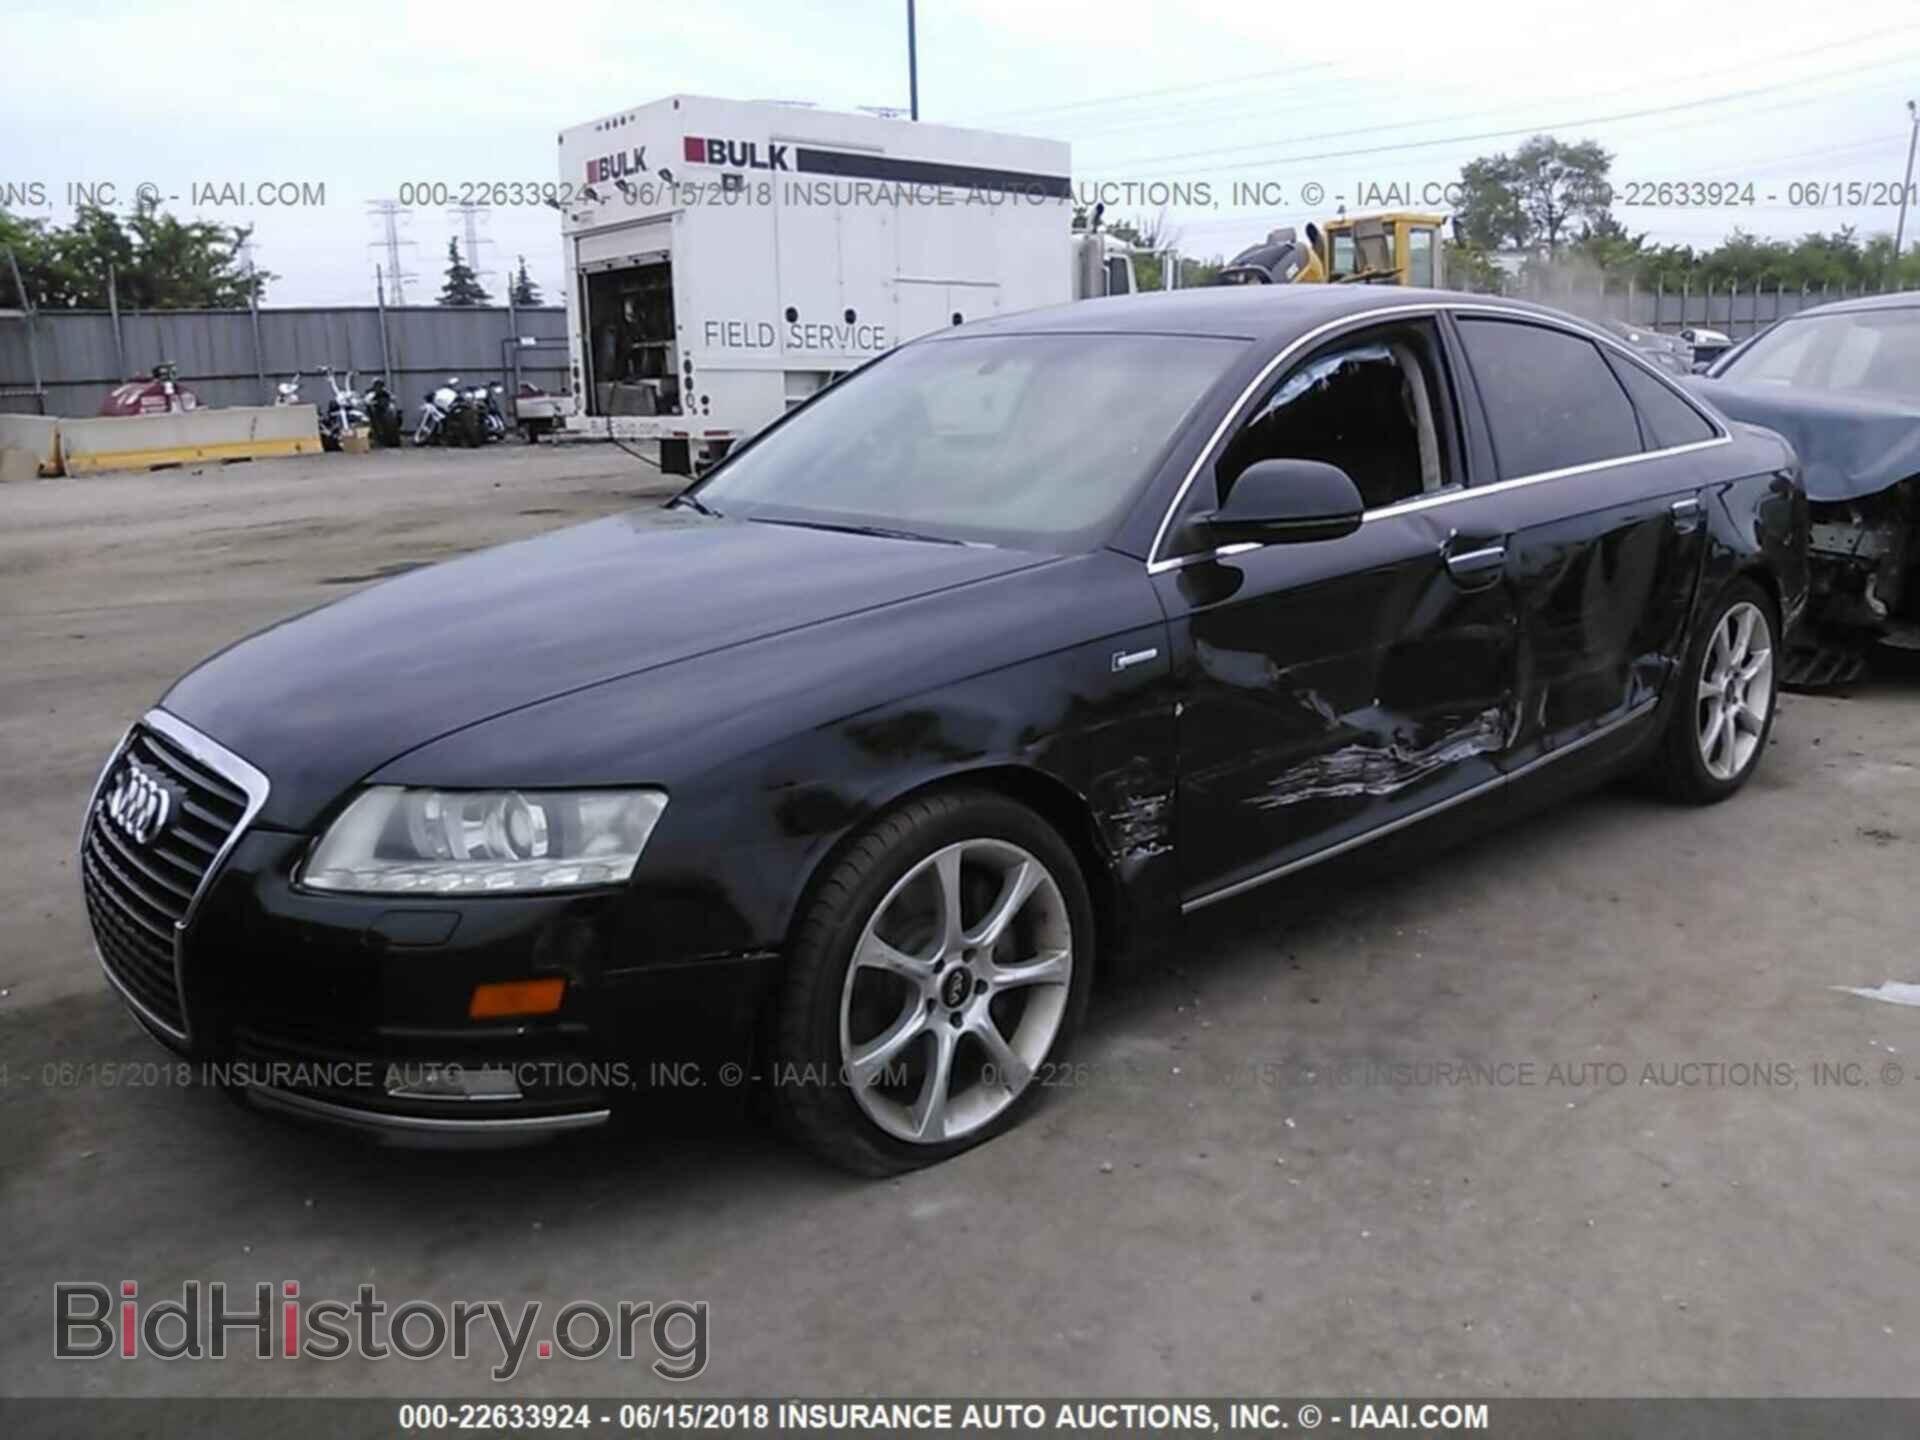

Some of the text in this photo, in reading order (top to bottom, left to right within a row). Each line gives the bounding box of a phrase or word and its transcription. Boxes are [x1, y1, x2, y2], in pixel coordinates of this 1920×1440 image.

[599, 146, 647, 181] BULK
[707, 139, 790, 171] BULK
[704, 321, 886, 350] FIELD SERVICE
